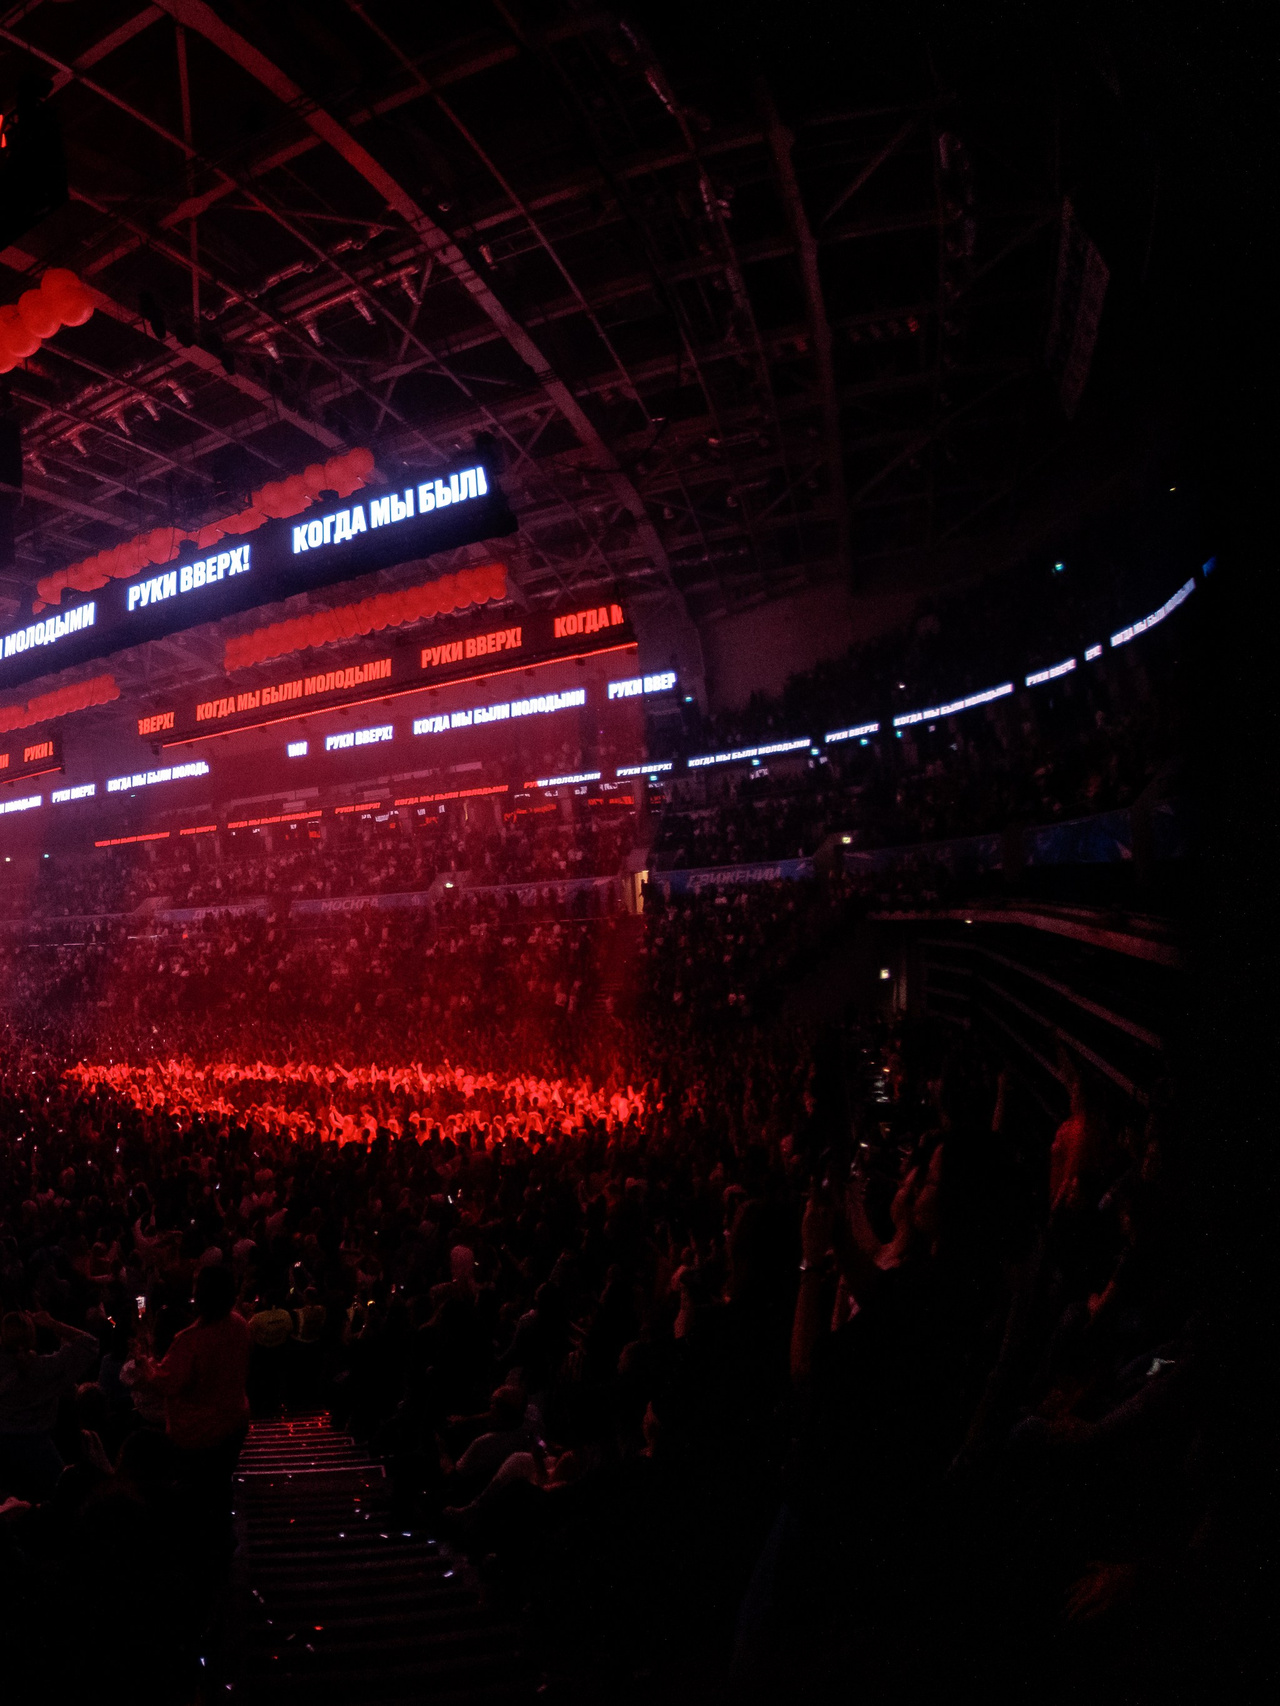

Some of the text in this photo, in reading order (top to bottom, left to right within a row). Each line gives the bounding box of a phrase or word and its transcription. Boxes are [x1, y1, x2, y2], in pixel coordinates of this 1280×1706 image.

[292, 505, 367, 554] КОГДА
[370, 489, 414, 529] МЫ
[127, 544, 251, 612] РУКИ ВВЕРХ!
[4, 602, 96, 658] МОЛОДЫМИ
[554, 609, 609, 638] КОГДА
[421, 626, 522, 669] РУКИ ВВЕРХ!
[196, 658, 392, 722] КОГДА МЫ БЫЛИ МОЛОДЫМИ
[608, 678, 643, 700] РУКИ
[413, 689, 586, 735] КОГДА МЫ БЫЛИ МОЛОДЫМИ
[24, 742, 48, 763] РУКИ
[326, 725, 394, 751] РУКИ ВВЕРХ!
[617, 762, 672, 778] РУКИ ВВЕРХ!
